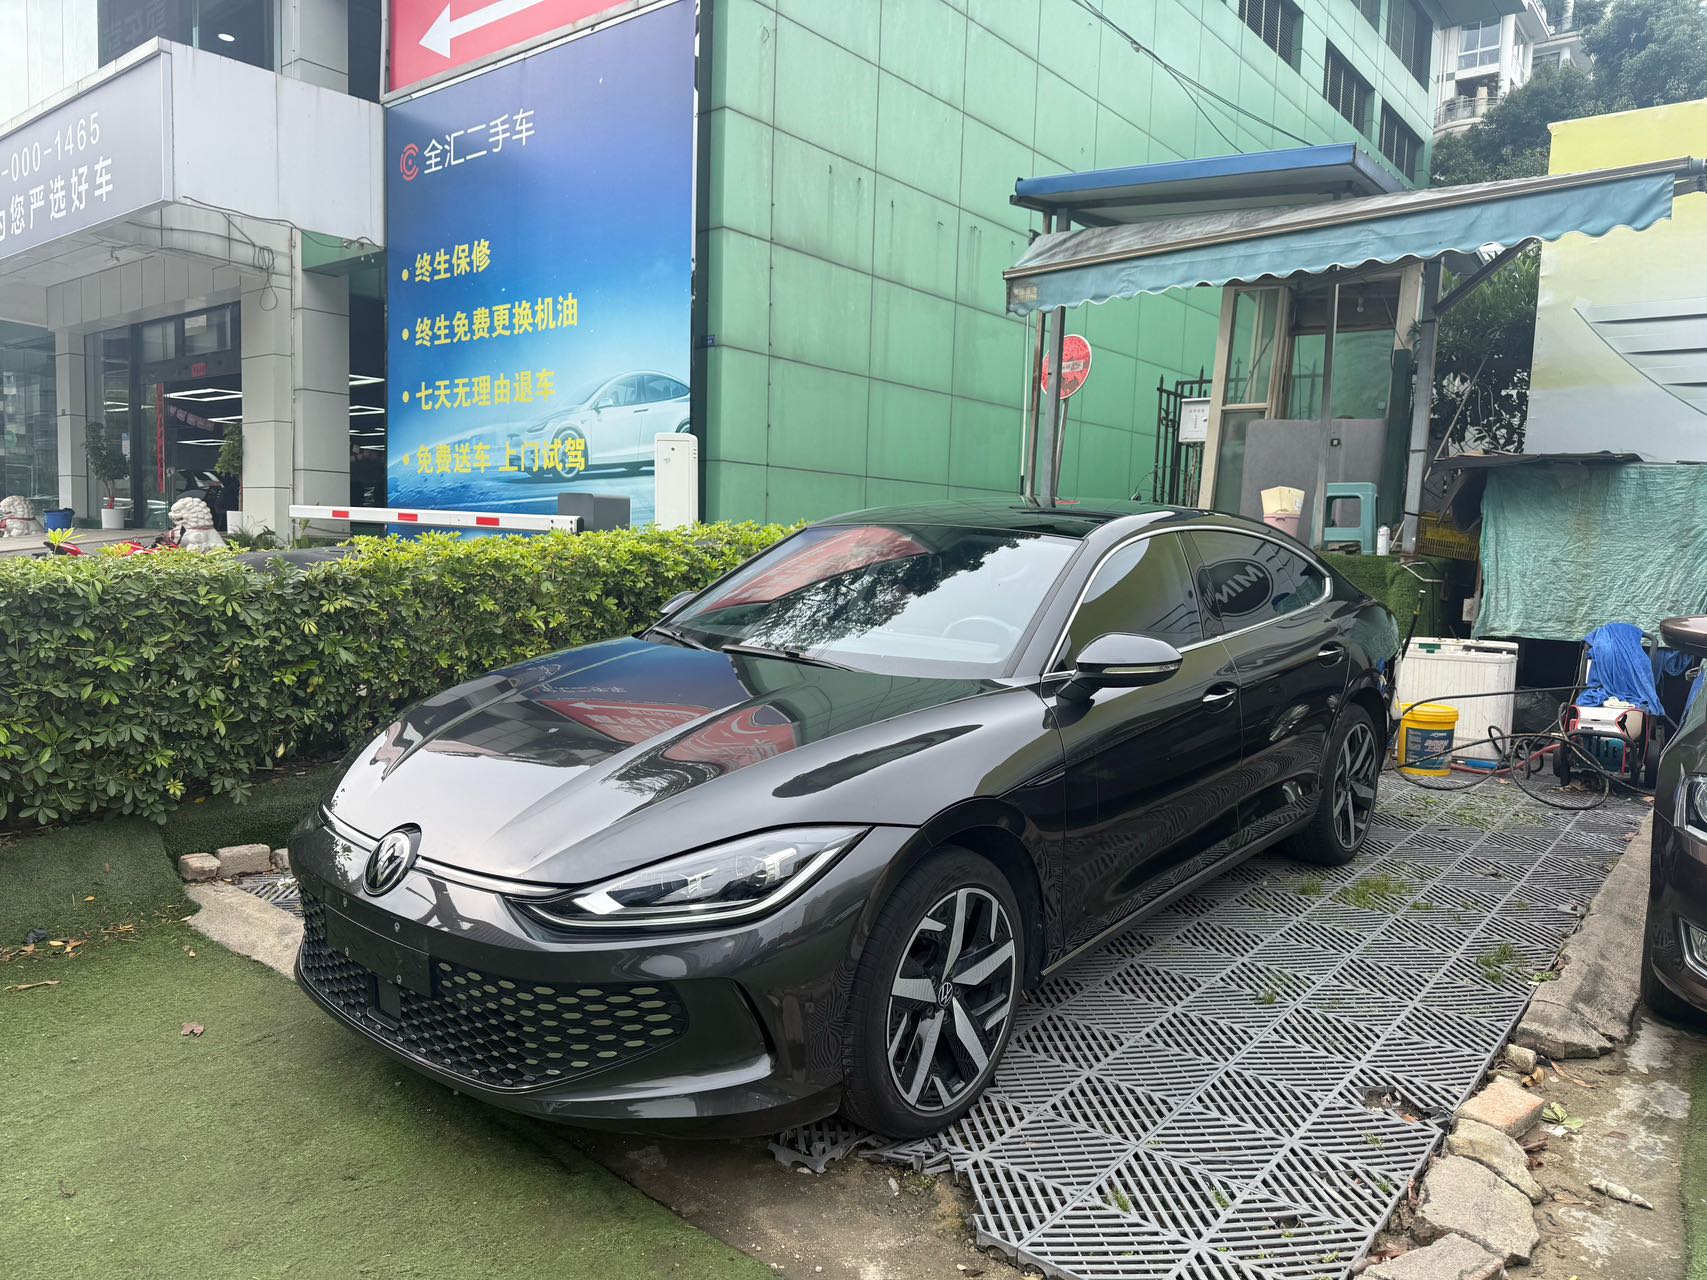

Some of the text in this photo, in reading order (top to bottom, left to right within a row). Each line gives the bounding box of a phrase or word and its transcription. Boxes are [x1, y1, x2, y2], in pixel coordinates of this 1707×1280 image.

[423, 108, 536, 174] 全汇二手车
[415, 238, 491, 282] 终生保修
[415, 292, 578, 347] 终生免费更换机油
[416, 368, 556, 411] 七天无理由退车
[416, 437, 586, 474] 免费送车 上门试驾
